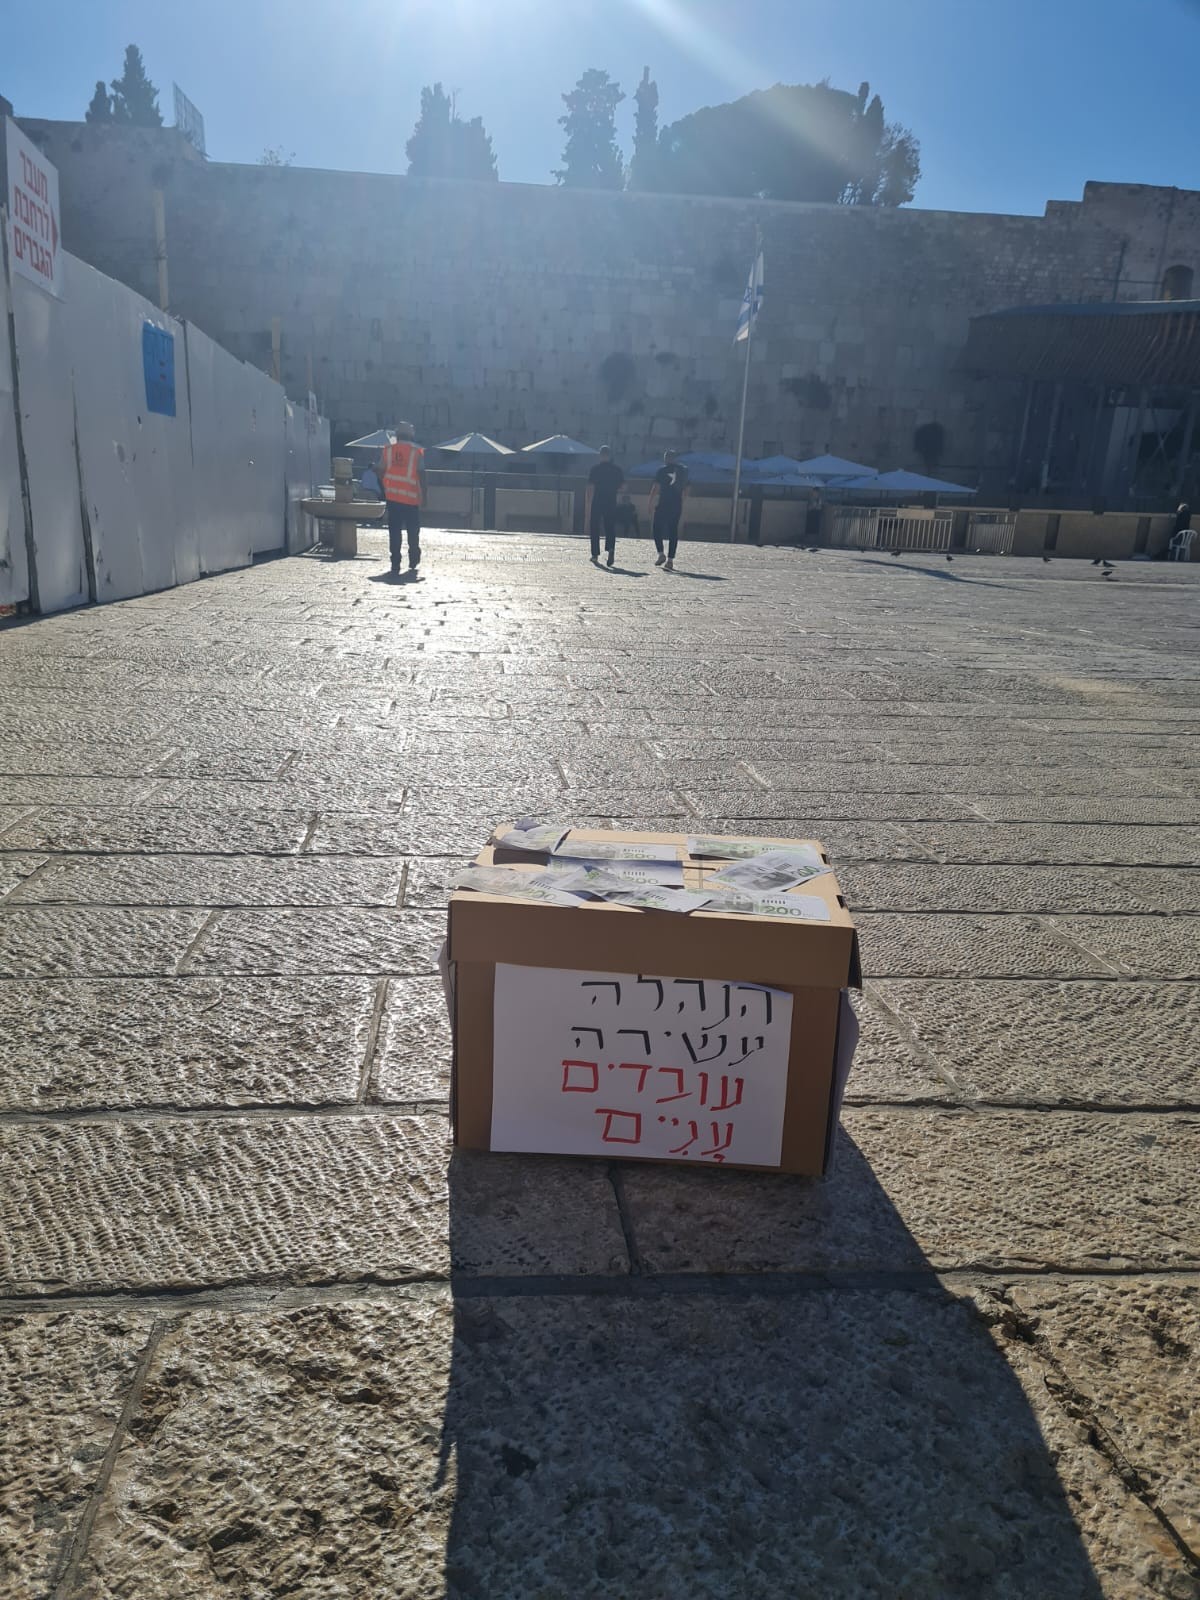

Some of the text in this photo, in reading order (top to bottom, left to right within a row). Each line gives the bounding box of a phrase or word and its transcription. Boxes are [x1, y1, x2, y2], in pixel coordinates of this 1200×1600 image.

[20, 150, 48, 205] מעבר
[14, 185, 49, 243] לרחבת
[14, 224, 53, 281] הגברים
[764, 905, 802, 917] 200
[581, 973, 772, 1031] הנהלה
[571, 1026, 764, 1067] עשירה
[562, 1060, 744, 1111] עובדים
